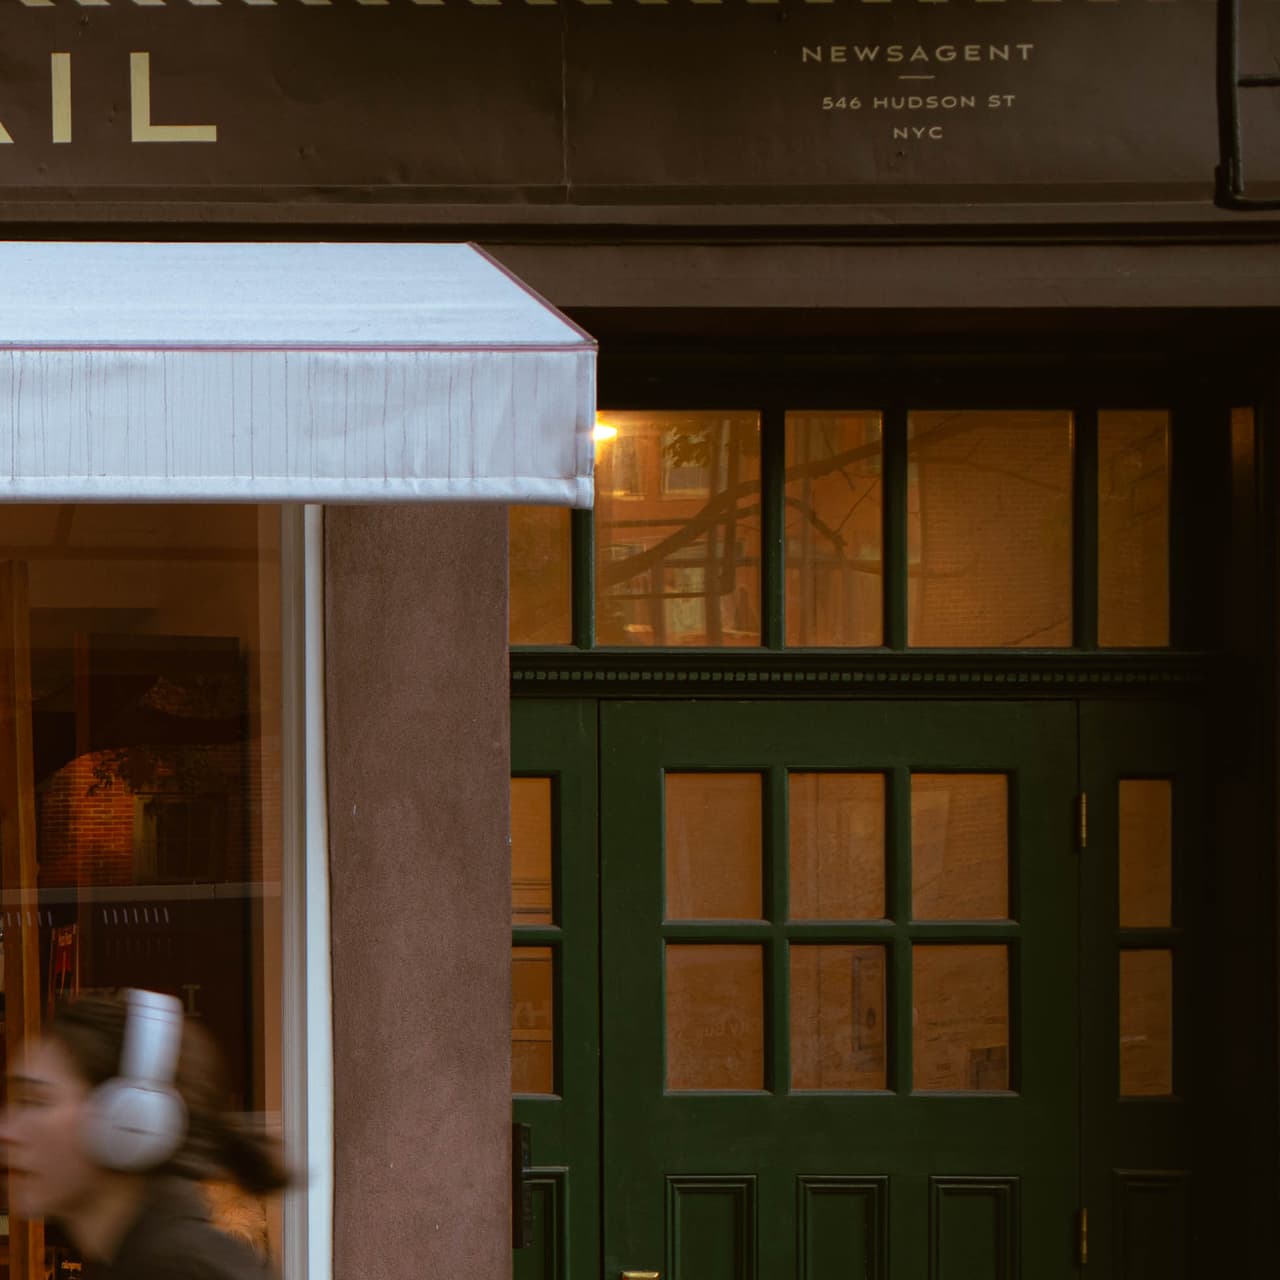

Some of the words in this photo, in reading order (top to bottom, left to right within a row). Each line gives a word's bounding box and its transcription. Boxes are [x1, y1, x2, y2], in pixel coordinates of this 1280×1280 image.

[801, 44, 1035, 63] NEWSAGENT
[821, 96, 862, 110] 546
[873, 95, 976, 109] HUDSON
[987, 94, 1016, 108] ST
[892, 126, 944, 140] NYC
